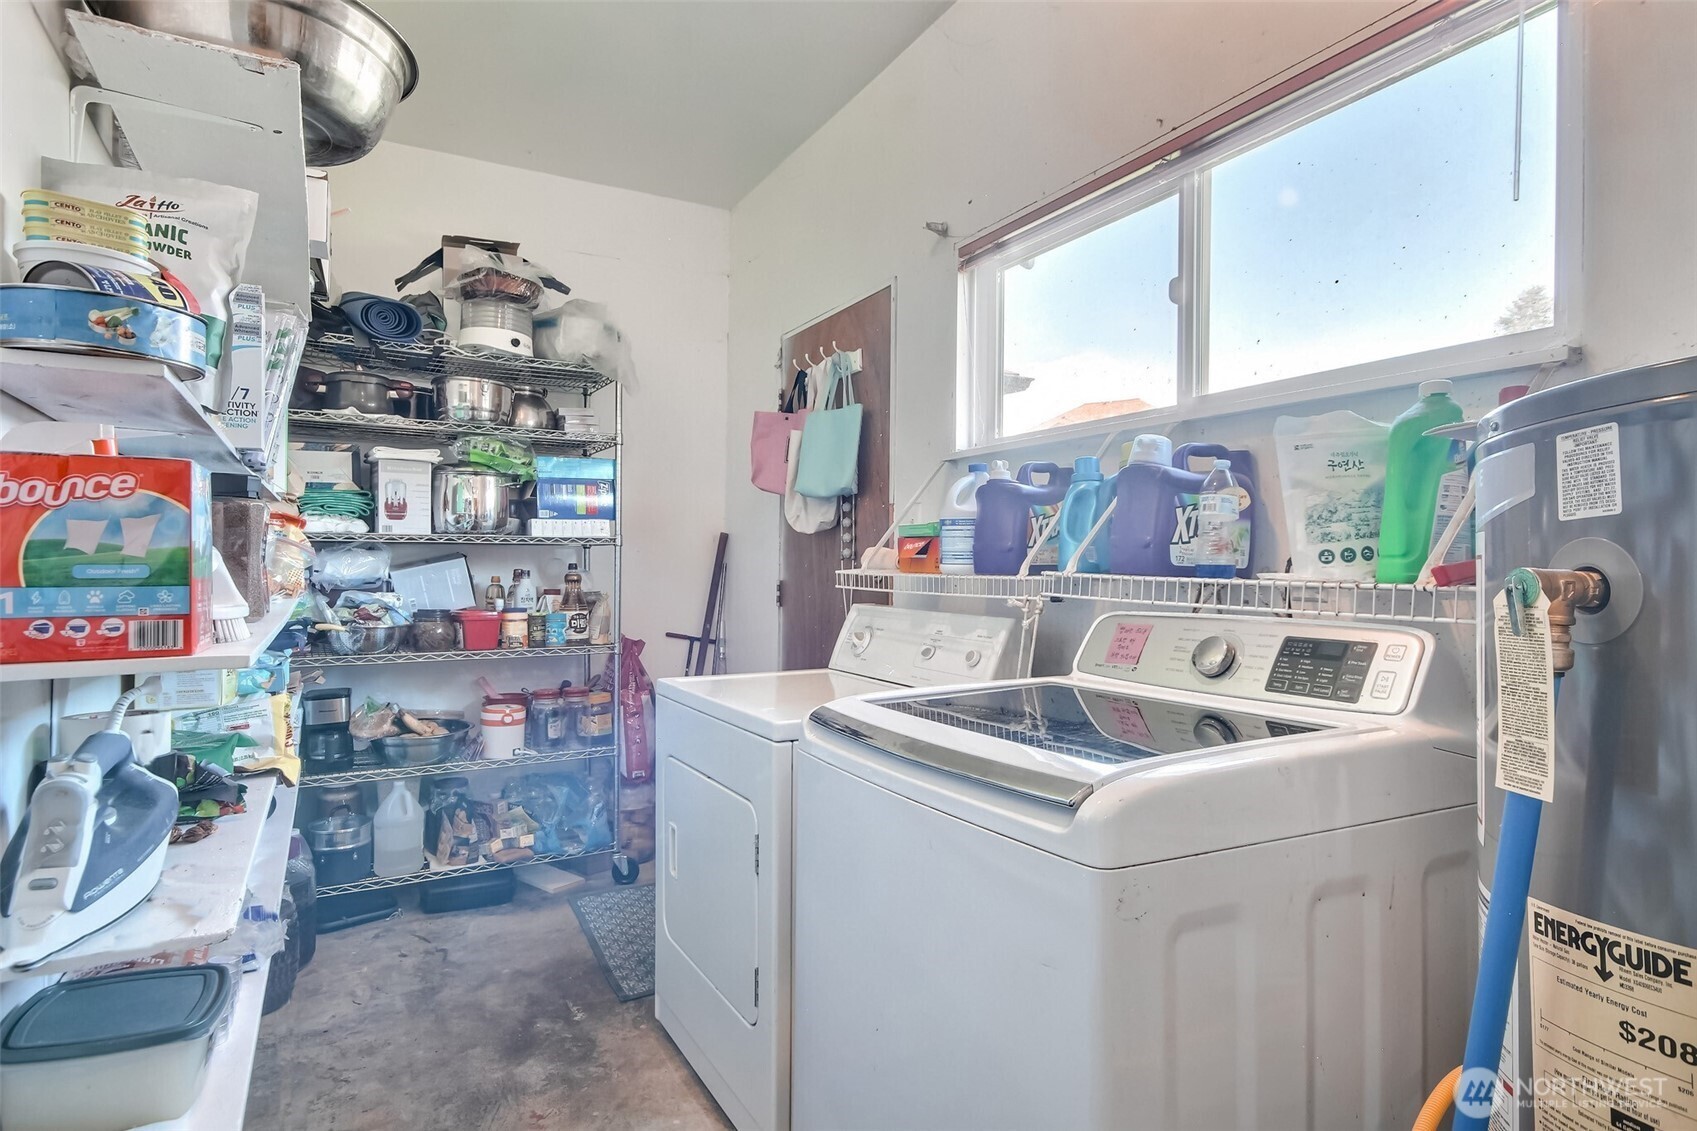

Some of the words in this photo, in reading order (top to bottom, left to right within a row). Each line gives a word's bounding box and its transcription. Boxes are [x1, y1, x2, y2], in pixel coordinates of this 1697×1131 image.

[54, 201, 81, 212] CENTO
[55, 218, 82, 229] CENTO
[181, 217, 209, 230] Creations
[1327, 459, 1365, 472] 구연산
[0, 472, 137, 506] bounce
[1534, 911, 1693, 987] ENERGYGUIDE
[1657, 945, 1677, 954] consumer
[1619, 974, 1631, 983] Model
[1632, 970, 1643, 979] Sales
[1556, 975, 1583, 994] Estimated
[1584, 987, 1604, 1003] Yearly
[1606, 996, 1630, 1012] Energy
[1631, 1006, 1648, 1018] Cost
[1618, 1020, 1697, 1067] $208
[1572, 1046, 1581, 1055] Cost
[1581, 1050, 1595, 1062] Range
[1600, 1058, 1617, 1071] Similar
[1617, 1066, 1635, 1079] Models
[1632, 1107, 1642, 1118] hour
